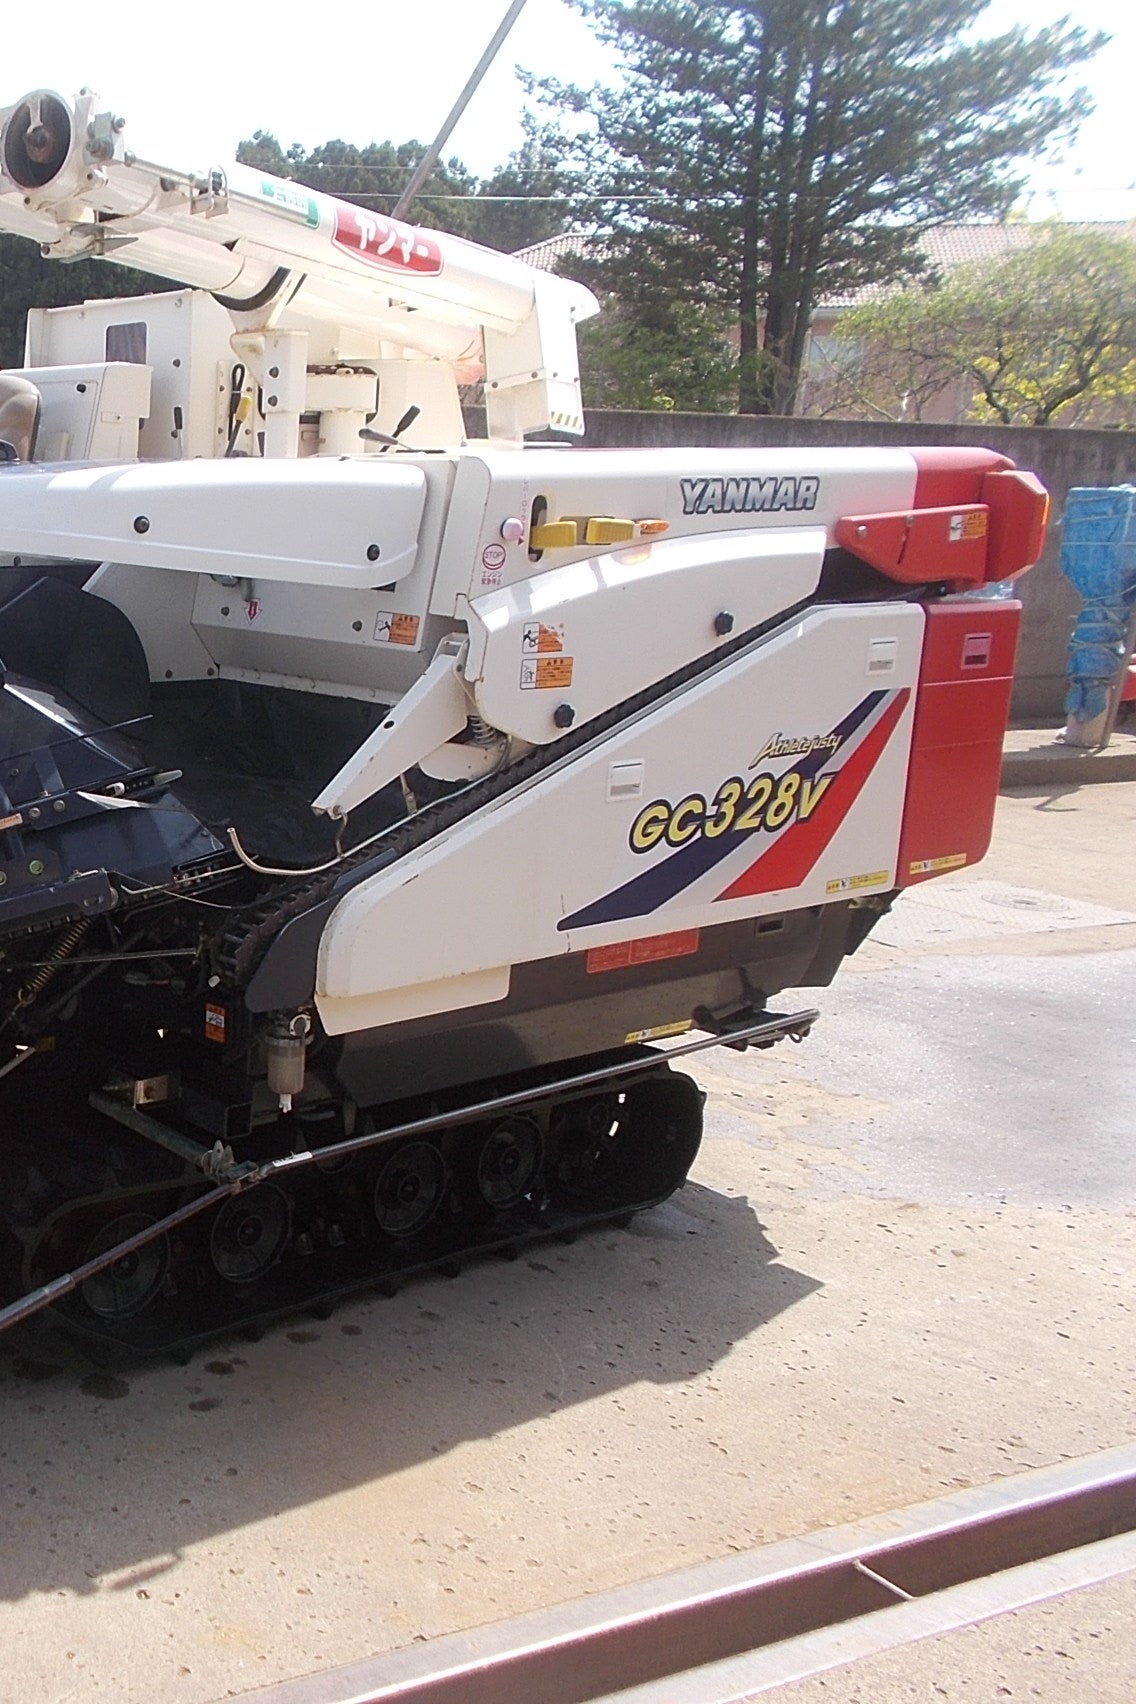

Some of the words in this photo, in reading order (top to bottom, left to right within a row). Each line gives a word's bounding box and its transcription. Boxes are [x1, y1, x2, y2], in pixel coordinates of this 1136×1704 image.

[354, 214, 429, 264] ヤンマー
[680, 476, 820, 515] YANMAR
[484, 551, 504, 559] STOP
